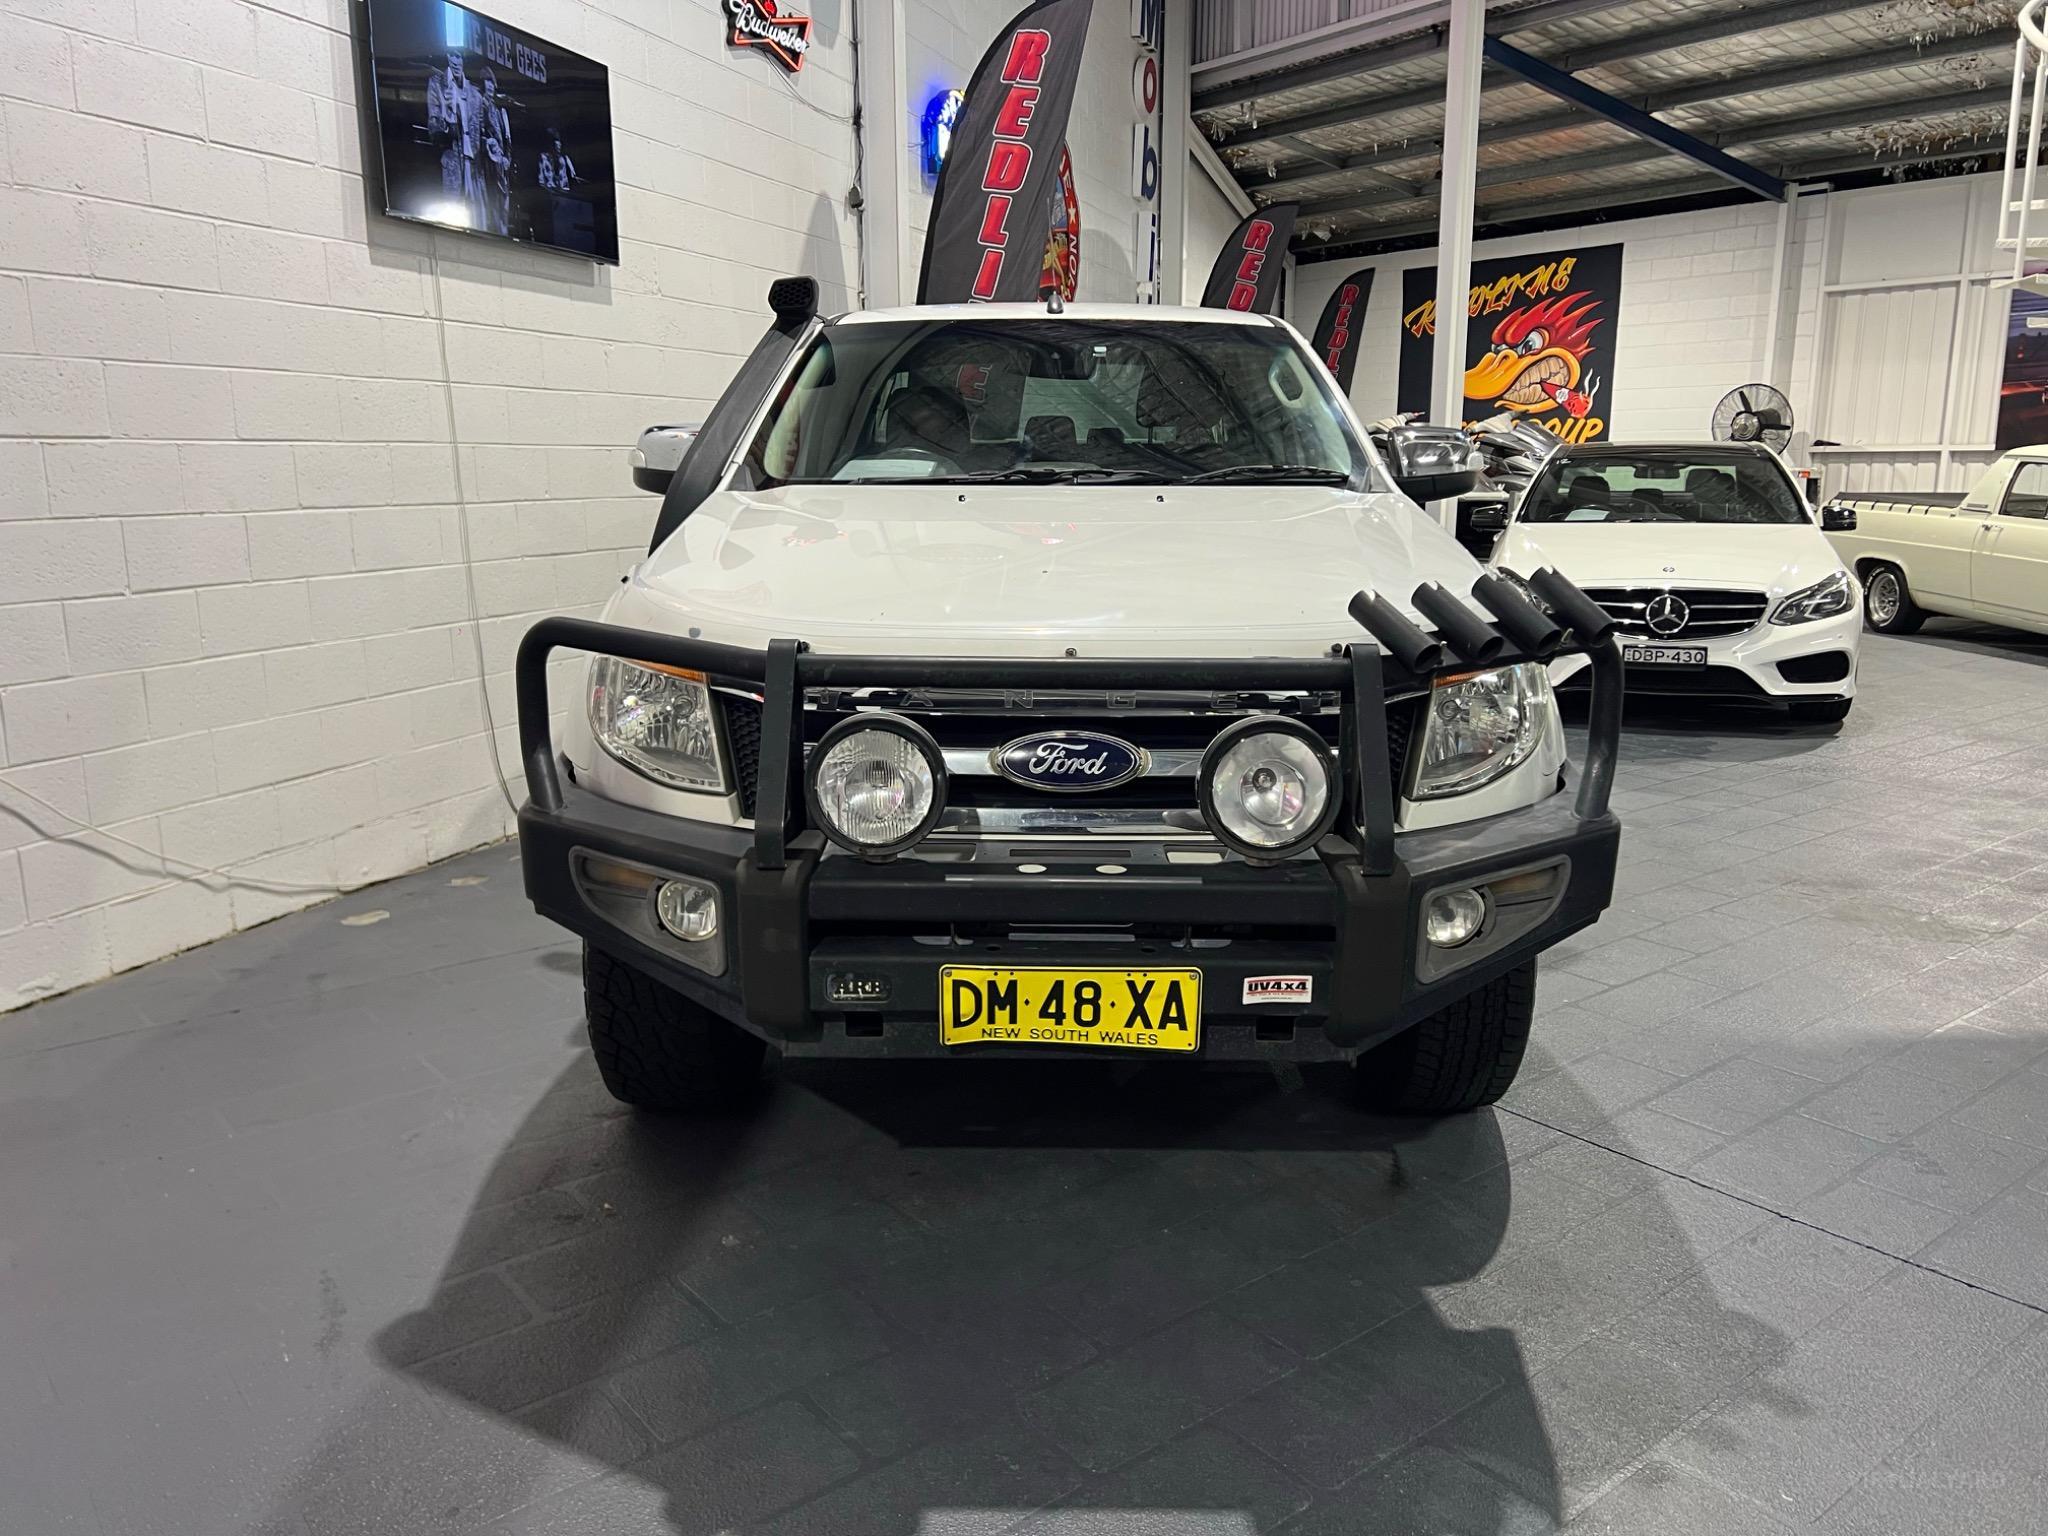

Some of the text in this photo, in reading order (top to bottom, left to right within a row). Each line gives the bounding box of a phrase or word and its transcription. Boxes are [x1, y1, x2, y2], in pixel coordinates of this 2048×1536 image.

[485, 26, 513, 69] BEE
[516, 43, 547, 83] GEES
[729, 0, 807, 54] Budweiser
[968, 29, 1051, 304] REDLI
[1403, 257, 1577, 338] RDLINE
[1029, 742, 1108, 775] Ford
[981, 1028, 1158, 1046] NEW SOUTH WALES
